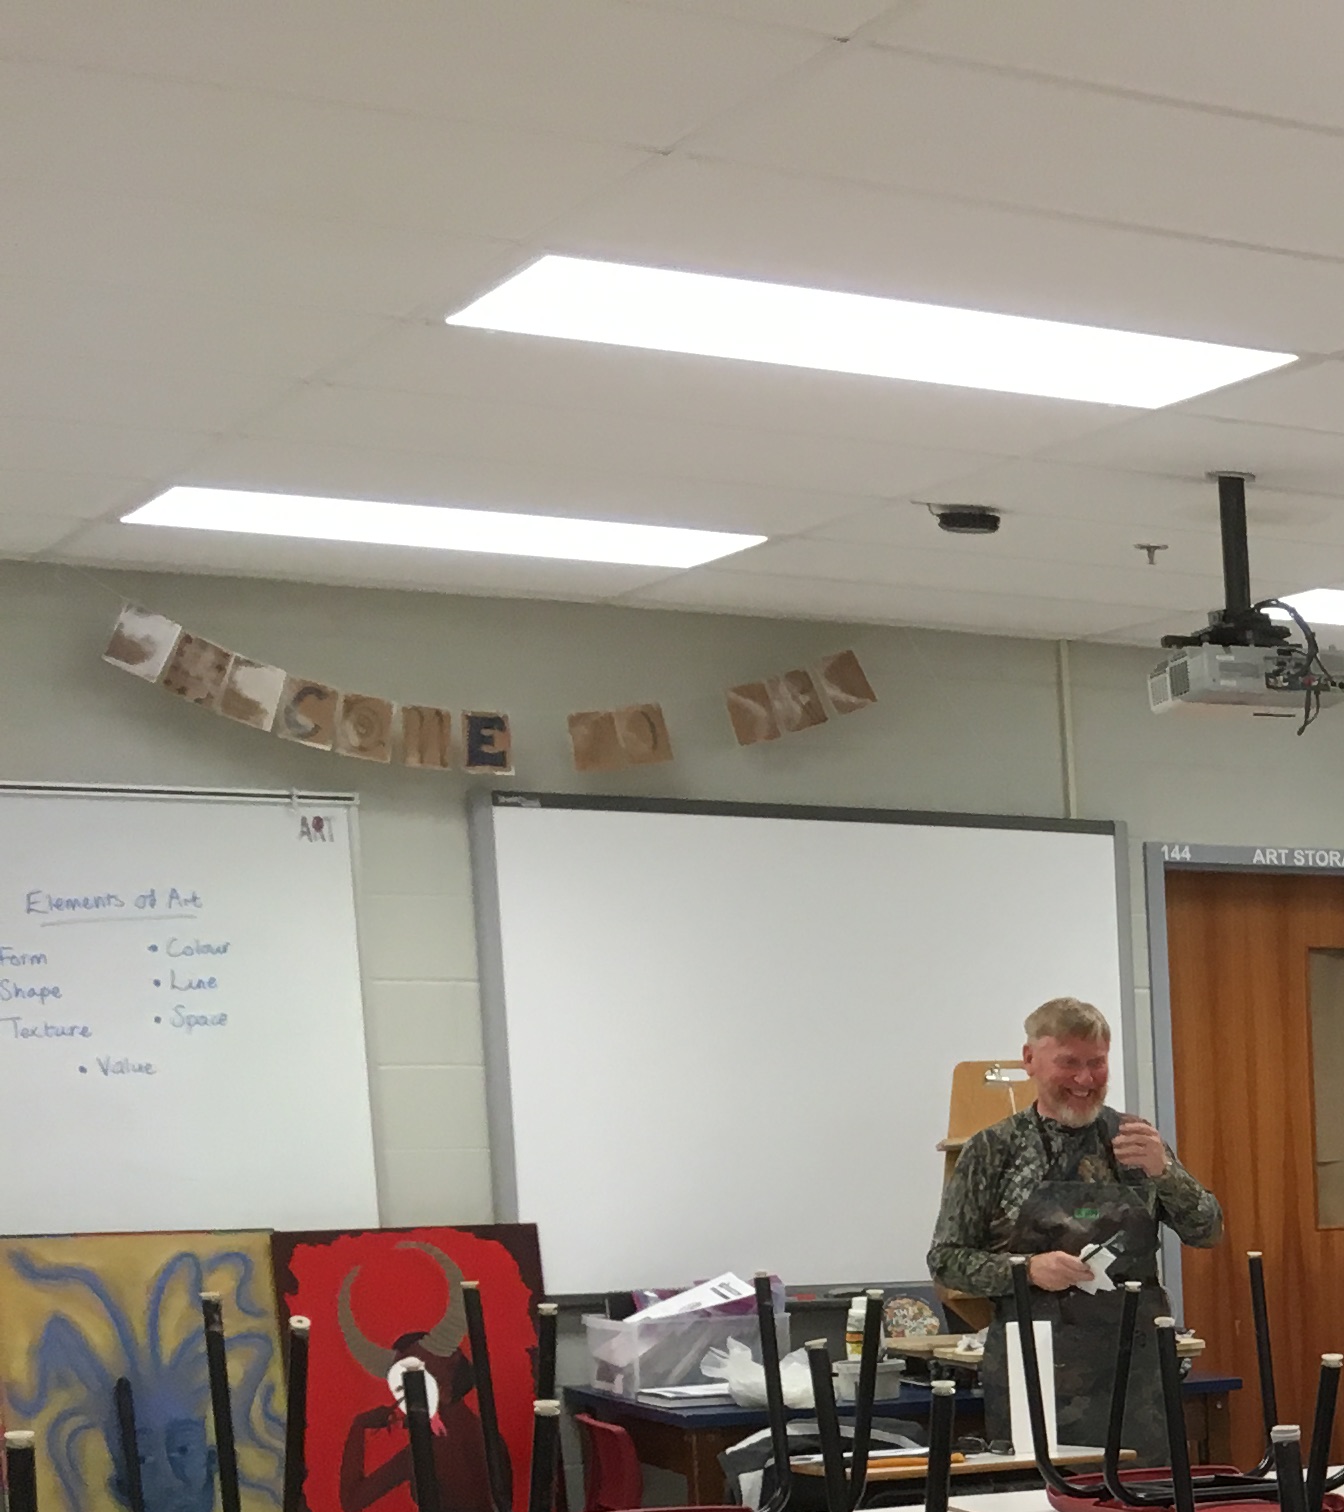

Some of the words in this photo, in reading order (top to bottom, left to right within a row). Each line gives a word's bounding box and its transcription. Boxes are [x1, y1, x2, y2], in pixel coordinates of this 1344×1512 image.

[1161, 844, 1192, 861] 144
[1252, 848, 1289, 864] ART
[25, 889, 125, 915] Elements
[168, 887, 204, 909] Art
[0, 946, 49, 967] Form
[165, 937, 231, 958] Colour
[169, 969, 219, 991] Line
[0, 979, 63, 1004] Shape
[0, 1016, 93, 1040] Texture
[171, 1004, 230, 1034] Space
[96, 1056, 157, 1077] Value
